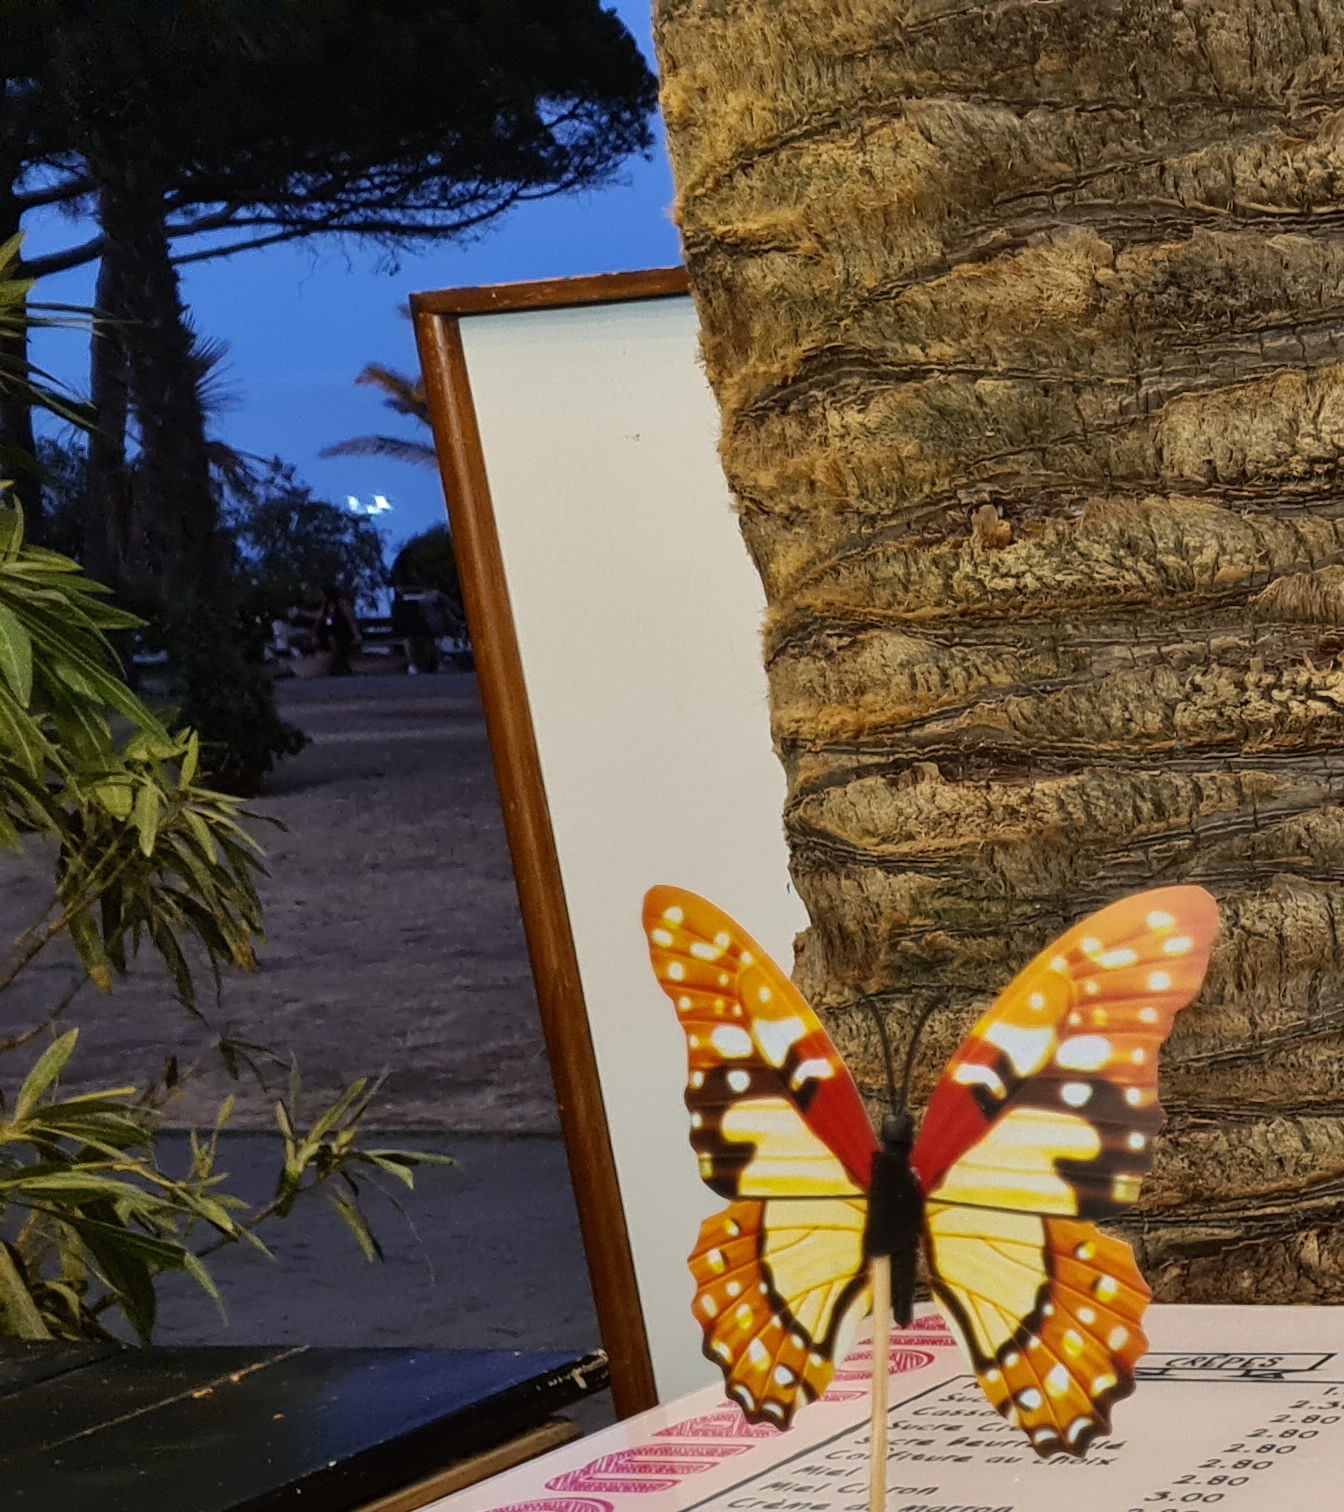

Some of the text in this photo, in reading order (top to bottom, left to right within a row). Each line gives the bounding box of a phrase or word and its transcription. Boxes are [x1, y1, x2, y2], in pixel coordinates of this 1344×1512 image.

[1268, 1414, 1341, 1425] 2.80
[1245, 1428, 1320, 1439] 2.80
[1222, 1443, 1297, 1455] 2.80
[825, 1449, 982, 1465] Cofiture
[1197, 1458, 1274, 1470] 2.80
[790, 1465, 863, 1477] Miel
[1172, 1474, 1250, 1487] 2.80
[758, 1481, 939, 1496] Miel Ciron
[1143, 1491, 1225, 1504] 3.00
[727, 1497, 832, 1511] Crème
